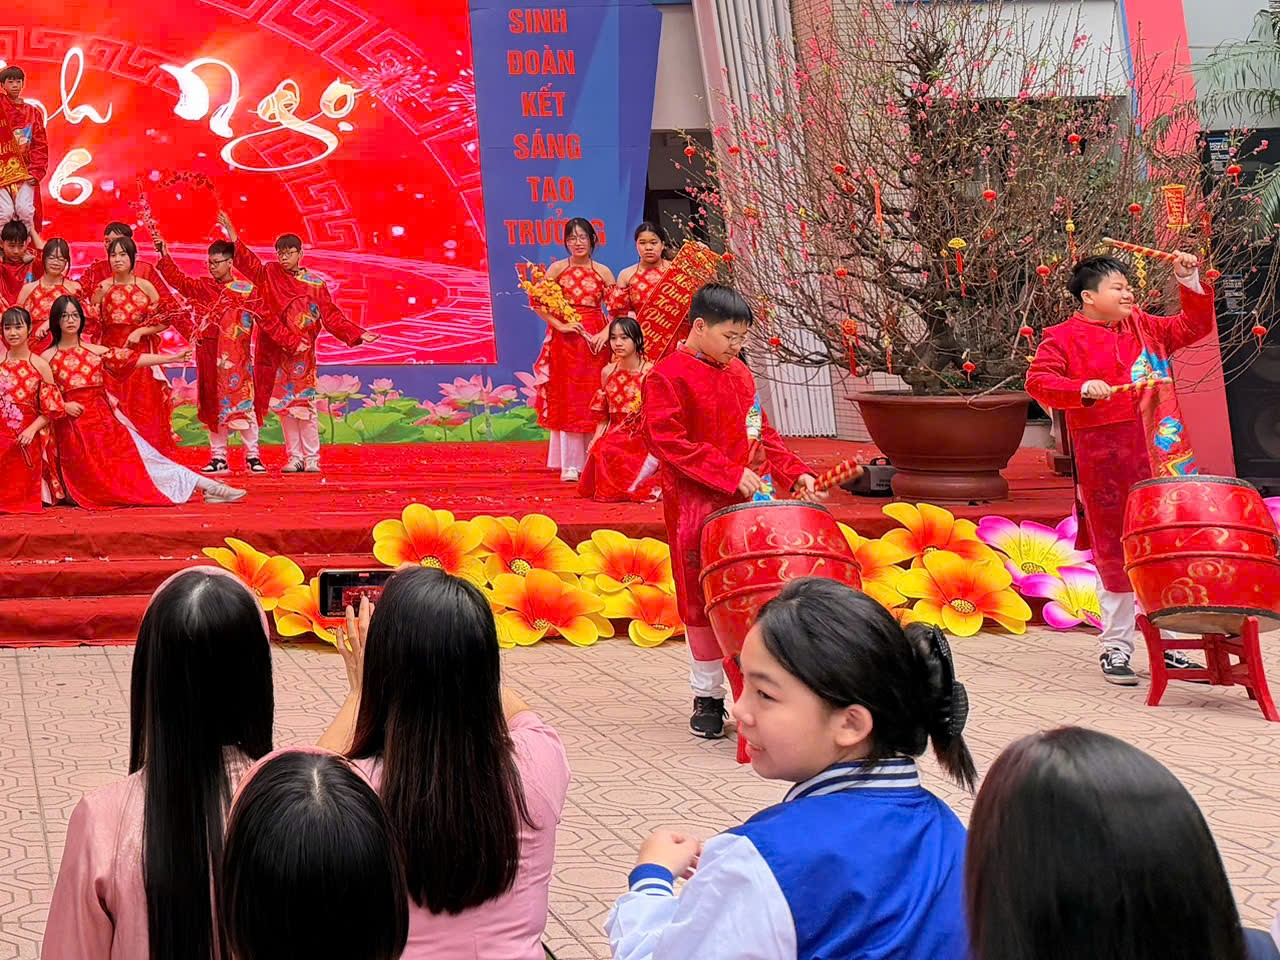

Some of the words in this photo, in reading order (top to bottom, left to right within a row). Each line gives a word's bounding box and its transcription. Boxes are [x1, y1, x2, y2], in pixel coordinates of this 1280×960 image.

[508, 9, 568, 34] SINH
[507, 44, 575, 75] ĐOÀN
[158, 57, 363, 172] Ngọ
[521, 82, 566, 118] KẾT
[513, 128, 582, 160] SÁNG
[526, 176, 575, 209] TẠO
[503, 208, 607, 246] TRƯỞG
